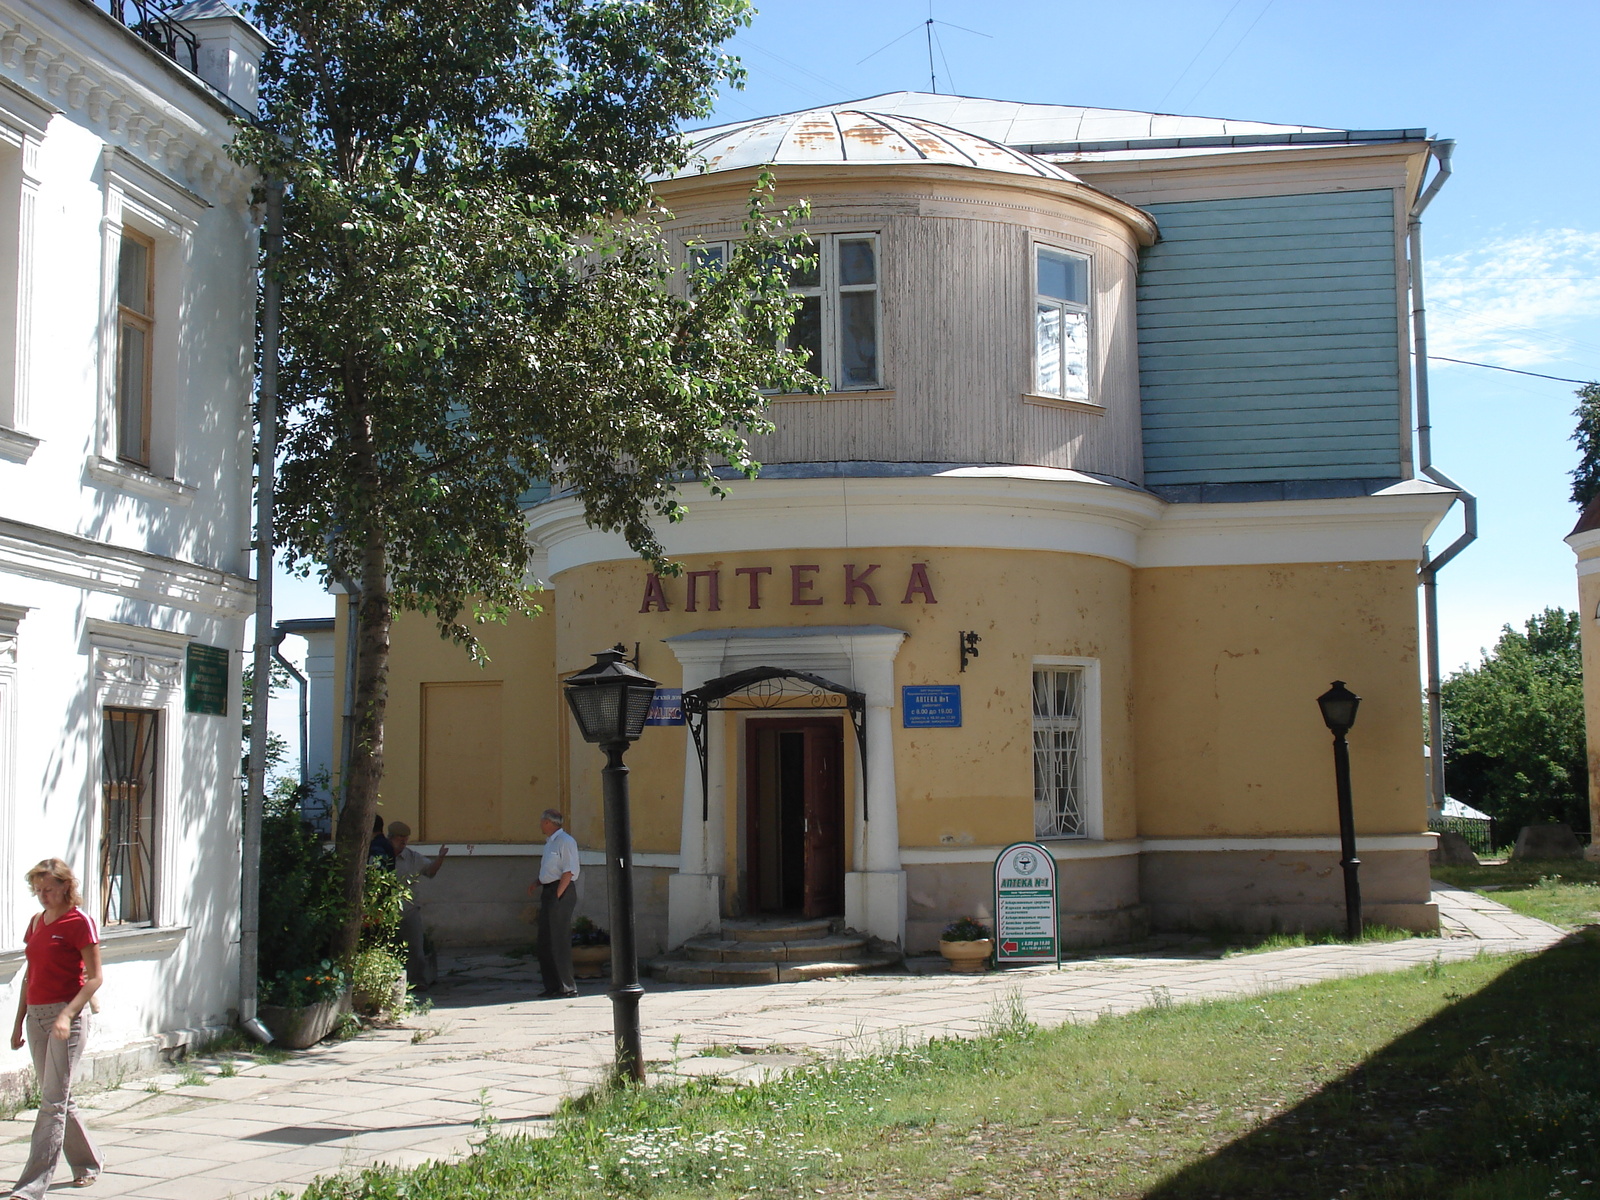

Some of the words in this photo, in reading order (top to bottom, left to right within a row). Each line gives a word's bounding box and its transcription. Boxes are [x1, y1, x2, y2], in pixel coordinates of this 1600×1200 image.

[638, 563, 938, 614] АПТЕКА
[1001, 878, 1033, 888] АПТЕКА
[1034, 877, 1049, 888] №1
